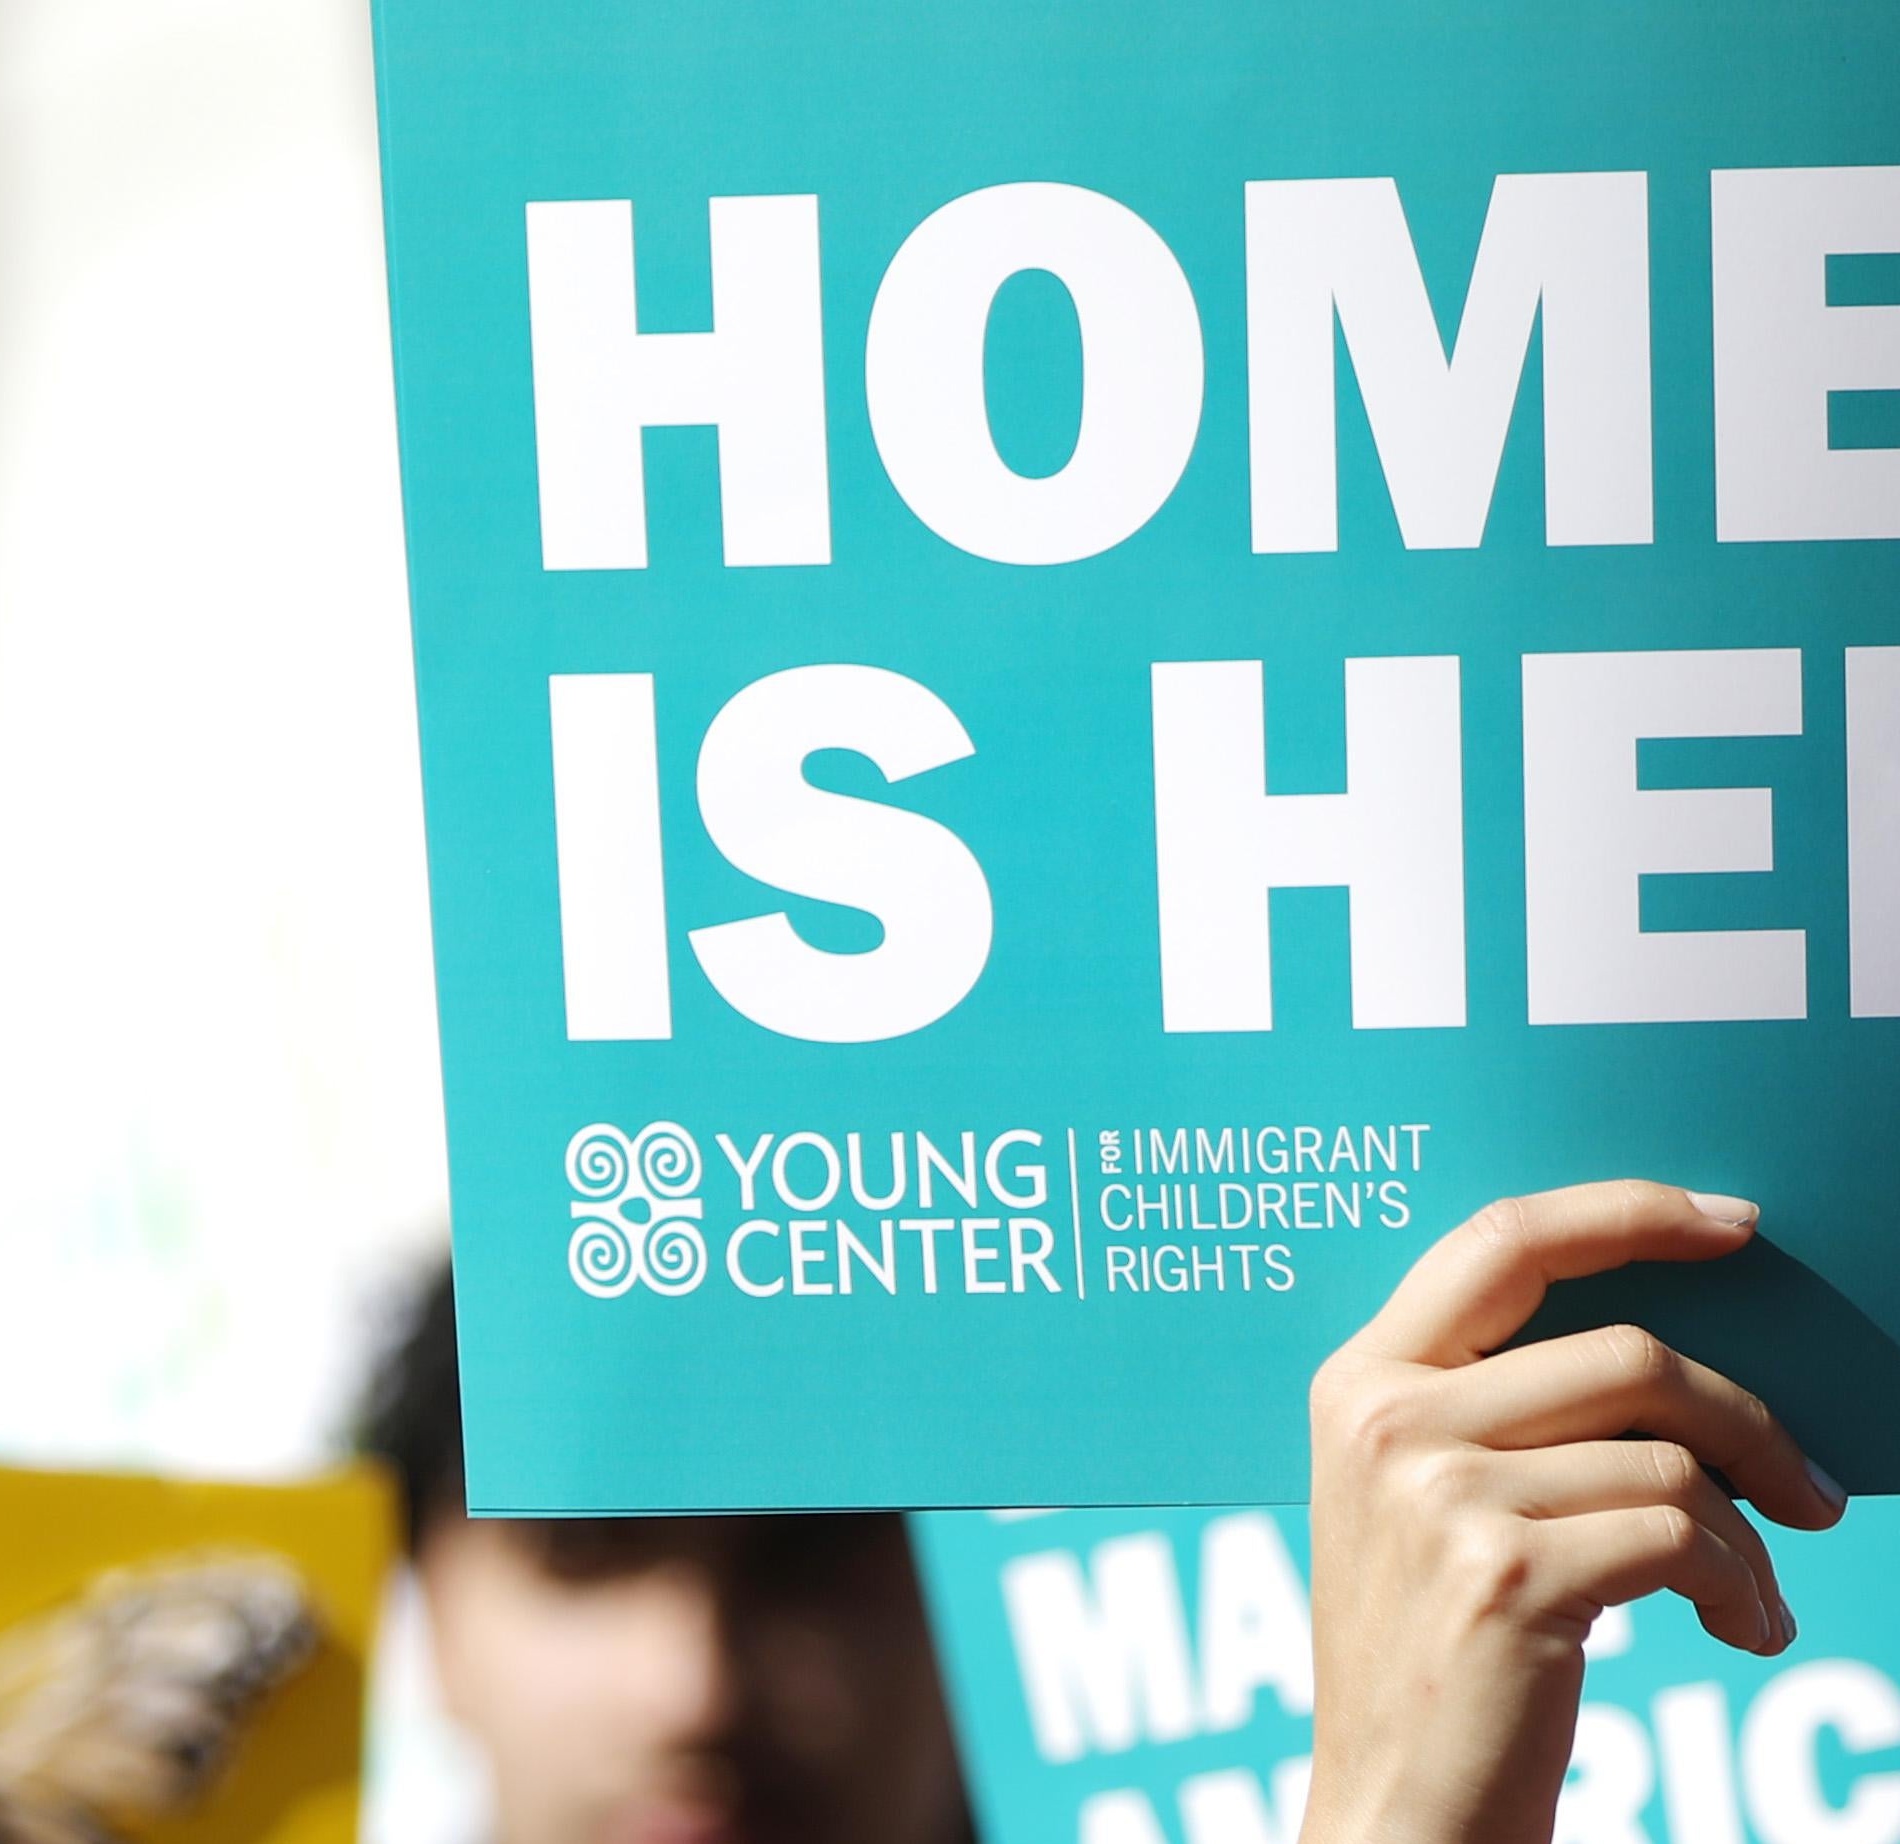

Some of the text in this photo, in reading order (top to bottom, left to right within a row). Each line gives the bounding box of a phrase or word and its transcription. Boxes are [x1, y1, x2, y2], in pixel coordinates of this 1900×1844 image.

[548, 663, 994, 1044] IS
[714, 1128, 1048, 1212] YOUNG
[1099, 1123, 1431, 1175] FOR IMMIGRANT
[1100, 1179, 1412, 1232] CHILDREN'S
[724, 1217, 1063, 1298] CENTER
[1106, 1243, 1297, 1293] RIGHTS
